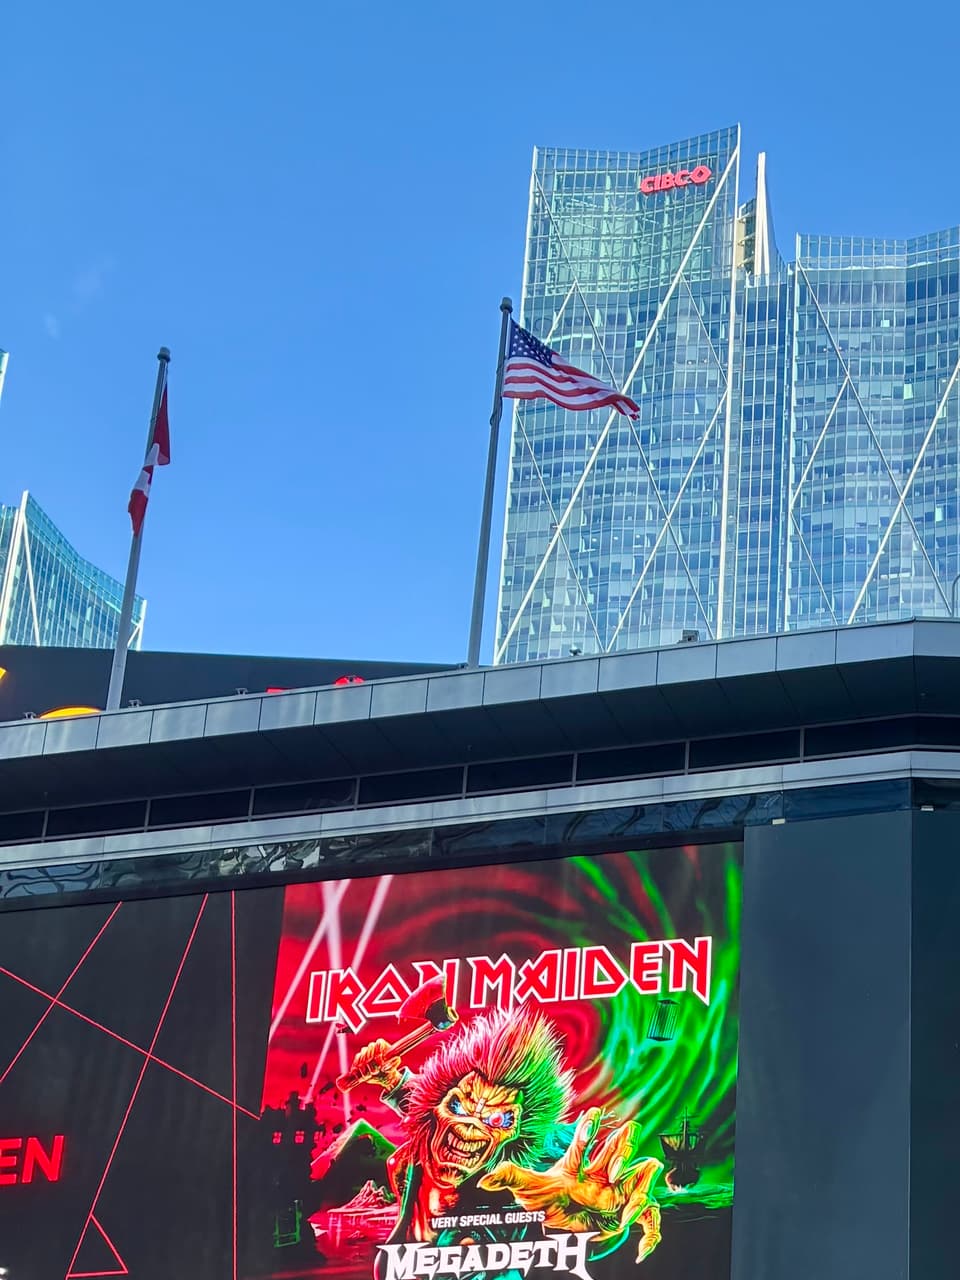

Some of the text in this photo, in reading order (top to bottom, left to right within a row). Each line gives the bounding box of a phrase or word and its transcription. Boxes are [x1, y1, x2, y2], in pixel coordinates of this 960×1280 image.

[641, 168, 690, 195] CIBC
[305, 935, 713, 1034] IRON MAIDEN
[431, 1210, 546, 1229] VERY SPECIAL GUESTS
